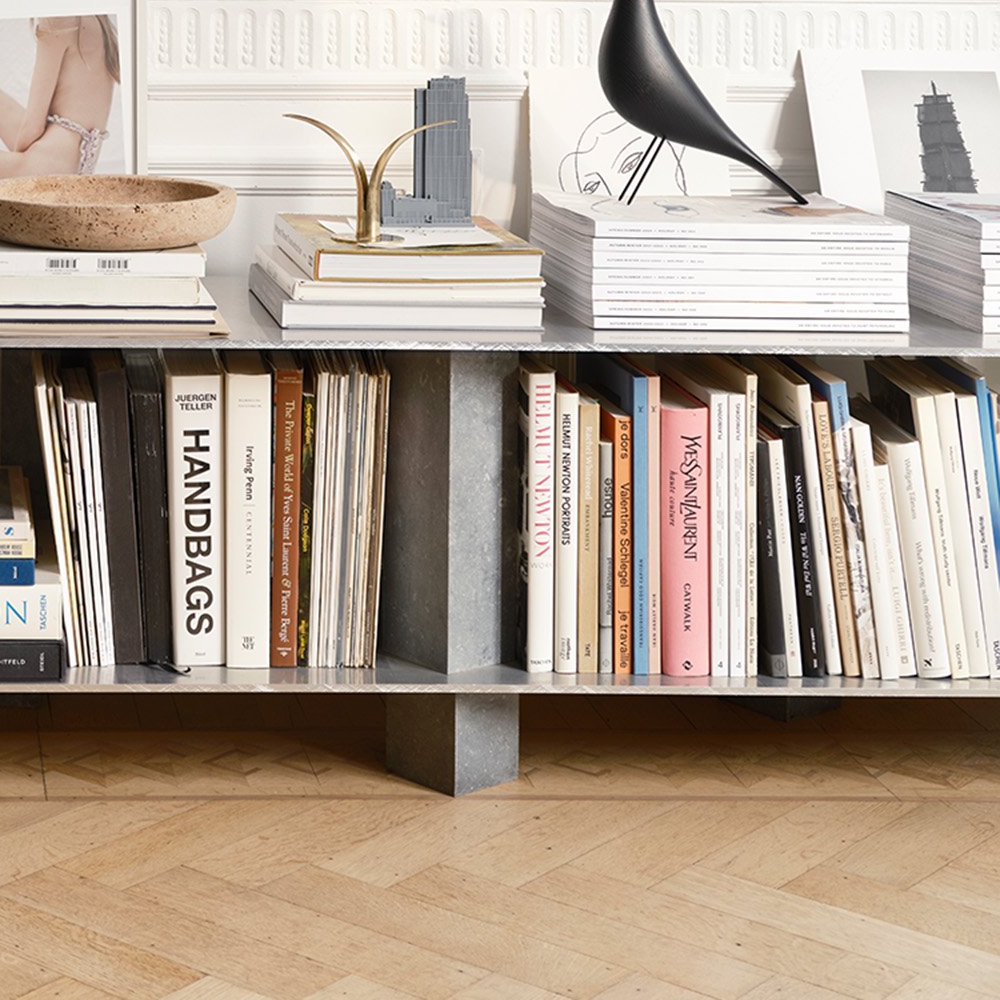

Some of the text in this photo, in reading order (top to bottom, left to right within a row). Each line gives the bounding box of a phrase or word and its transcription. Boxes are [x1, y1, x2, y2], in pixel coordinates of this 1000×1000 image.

[174, 393, 217, 403] JUERGEN
[179, 402, 213, 411] TELLER
[284, 400, 296, 418] The
[284, 420, 295, 452] Private
[243, 445, 256, 501] Irving Penn
[283, 453, 295, 482] World
[534, 384, 552, 558] HELMUT NEWTON
[561, 413, 572, 546] HELMUT NEWTON PORTRAITS
[584, 456, 594, 501] Whiteread
[903, 457, 915, 492] Wolfgang
[283, 483, 294, 493] of
[601, 478, 613, 519] house
[668, 469, 679, 527] haute couture
[794, 474, 803, 493] NAN
[282, 494, 294, 514] Yves
[818, 414, 848, 601] LOVE'S LABOUR SERGIO PURTELL
[934, 488, 943, 514] Wolfgang
[183, 429, 215, 636] HANDBAGS
[282, 516, 293, 540] Saint
[978, 515, 988, 543] Wolfgang
[281, 542, 293, 576] Laurent
[617, 420, 631, 669] je dors Valentine Schlegel je travaille
[916, 566, 926, 589] wrong
[280, 590, 292, 616] Pierre
[682, 582, 692, 632] CATWALK
[920, 589, 929, 605] with
[39, 594, 48, 631] TASCHEN
[278, 618, 292, 643] Bergé
